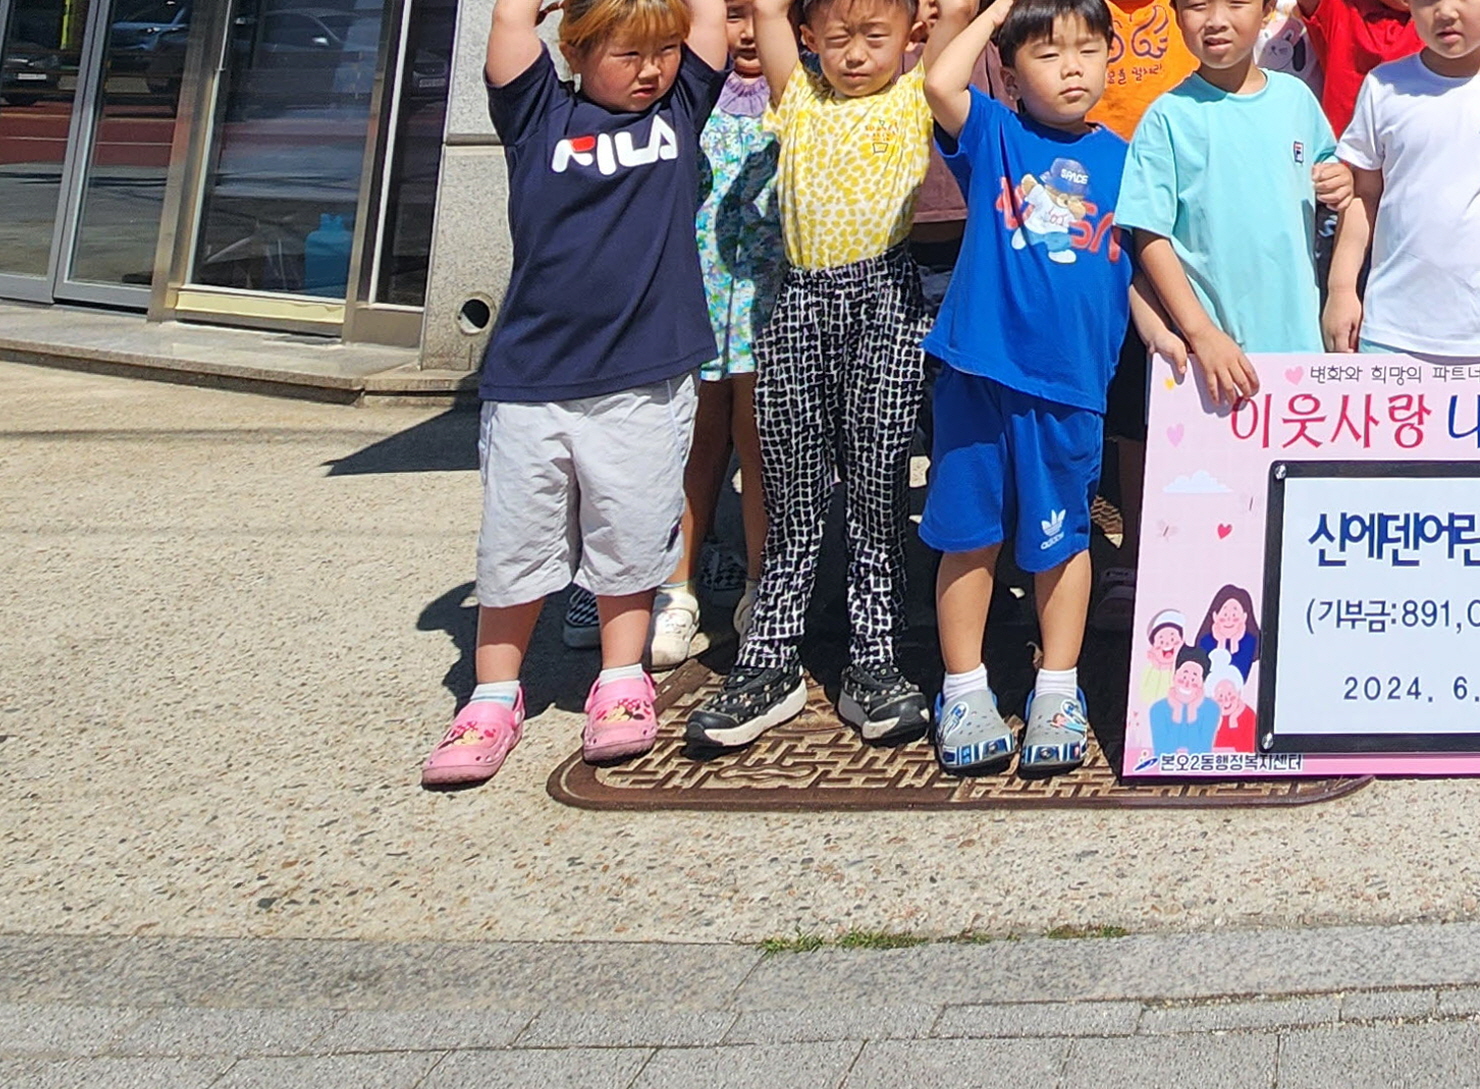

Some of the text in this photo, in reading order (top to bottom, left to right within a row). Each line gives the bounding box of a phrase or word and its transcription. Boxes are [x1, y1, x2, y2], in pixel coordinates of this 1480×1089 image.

[552, 115, 678, 176] FILA
[1061, 169, 1088, 184] SPACE
[1310, 365, 1363, 385] 변화와
[1371, 365, 1422, 387] 희망의
[1230, 393, 1433, 449] 이웃사랑
[1344, 676, 1433, 703] 2024.
[1453, 676, 1480, 703] 6.
[1161, 753, 1302, 772] 본오2동행정복지센터
